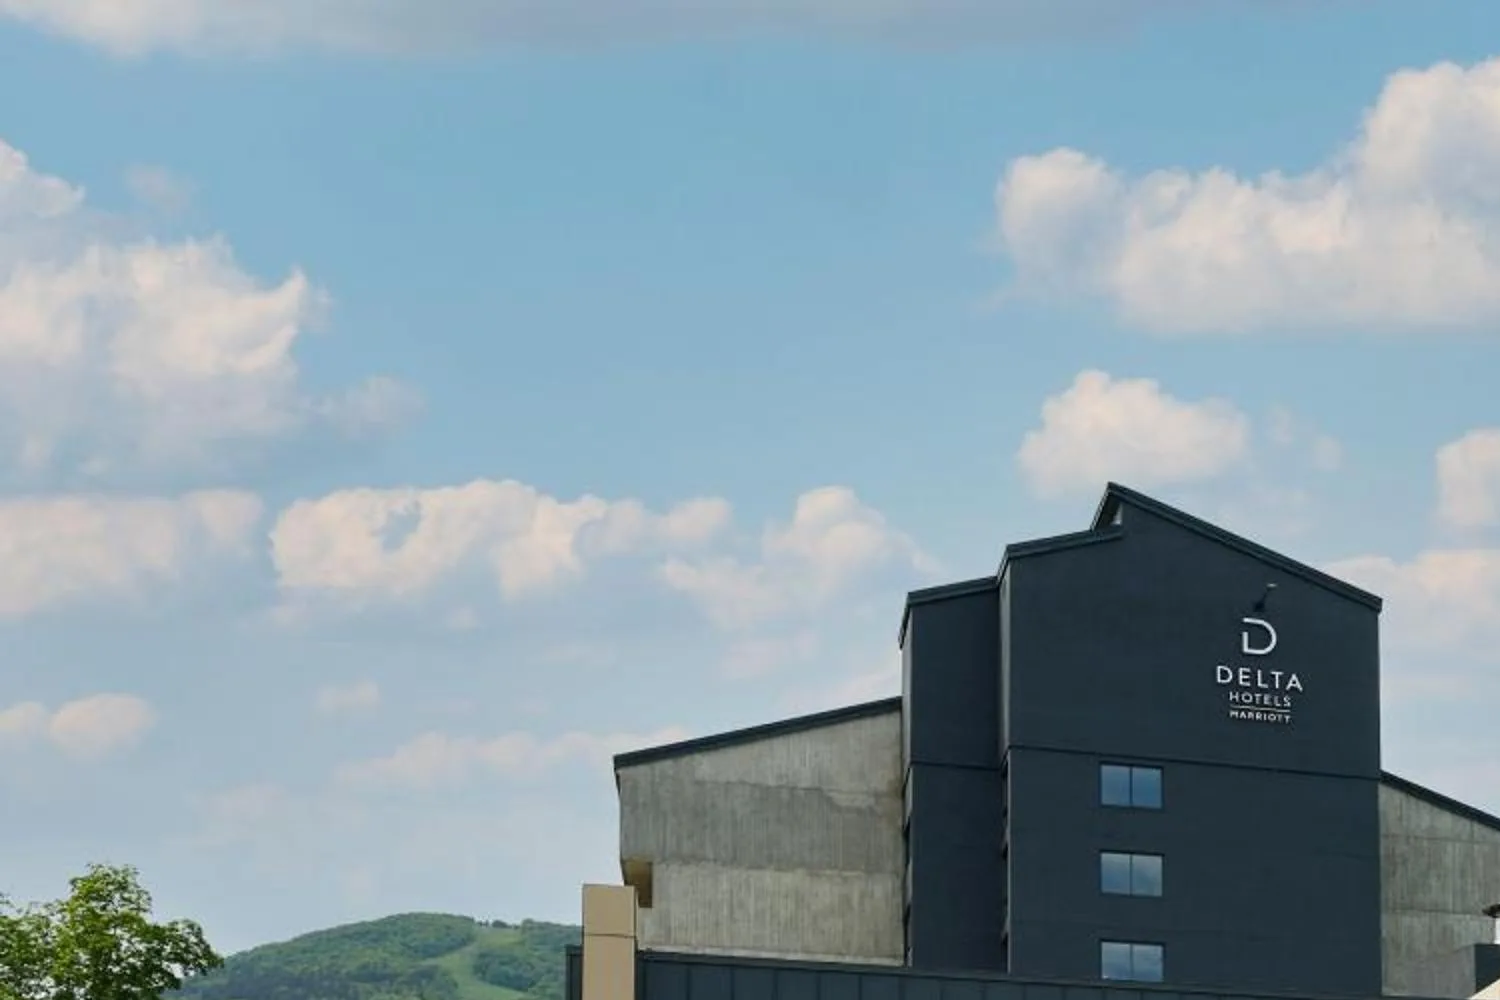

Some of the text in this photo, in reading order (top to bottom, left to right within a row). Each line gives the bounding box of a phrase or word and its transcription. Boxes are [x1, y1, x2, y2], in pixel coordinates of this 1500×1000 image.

[1241, 617, 1277, 654] D
[1216, 665, 1303, 692] DELTA
[1229, 691, 1291, 707] HOTELS
[1229, 710, 1291, 724] MARRIOTT
